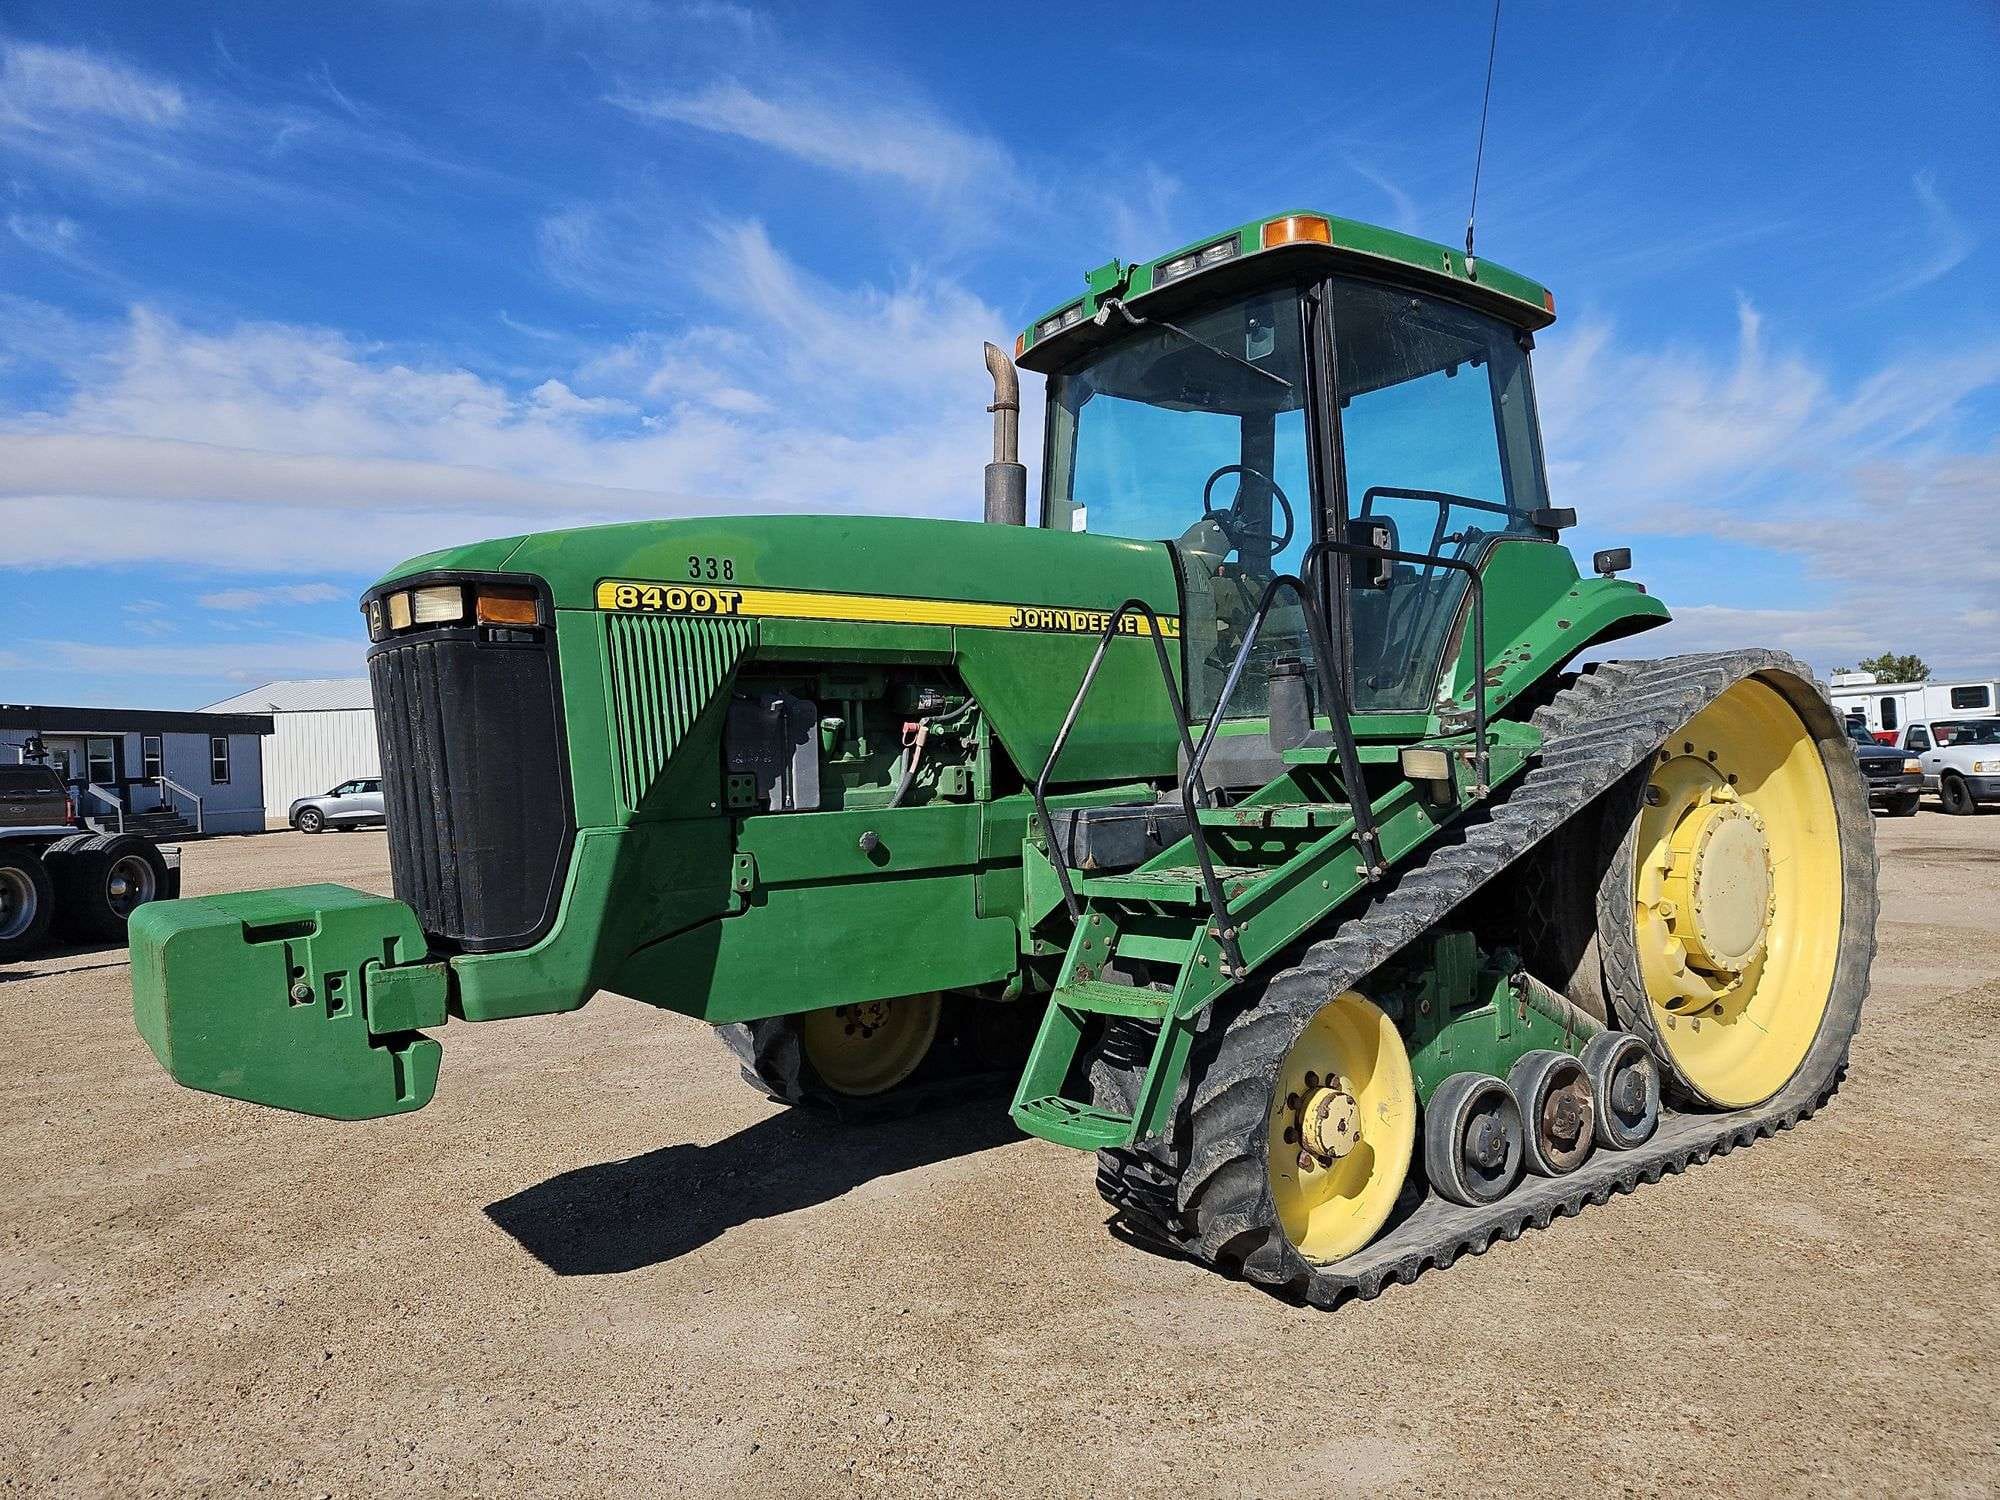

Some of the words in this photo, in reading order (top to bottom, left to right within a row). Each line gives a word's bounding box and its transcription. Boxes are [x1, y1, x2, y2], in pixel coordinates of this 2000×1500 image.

[688, 556, 734, 580] 338
[616, 586, 740, 613] 8400T
[1010, 609, 1068, 630] JOHN
